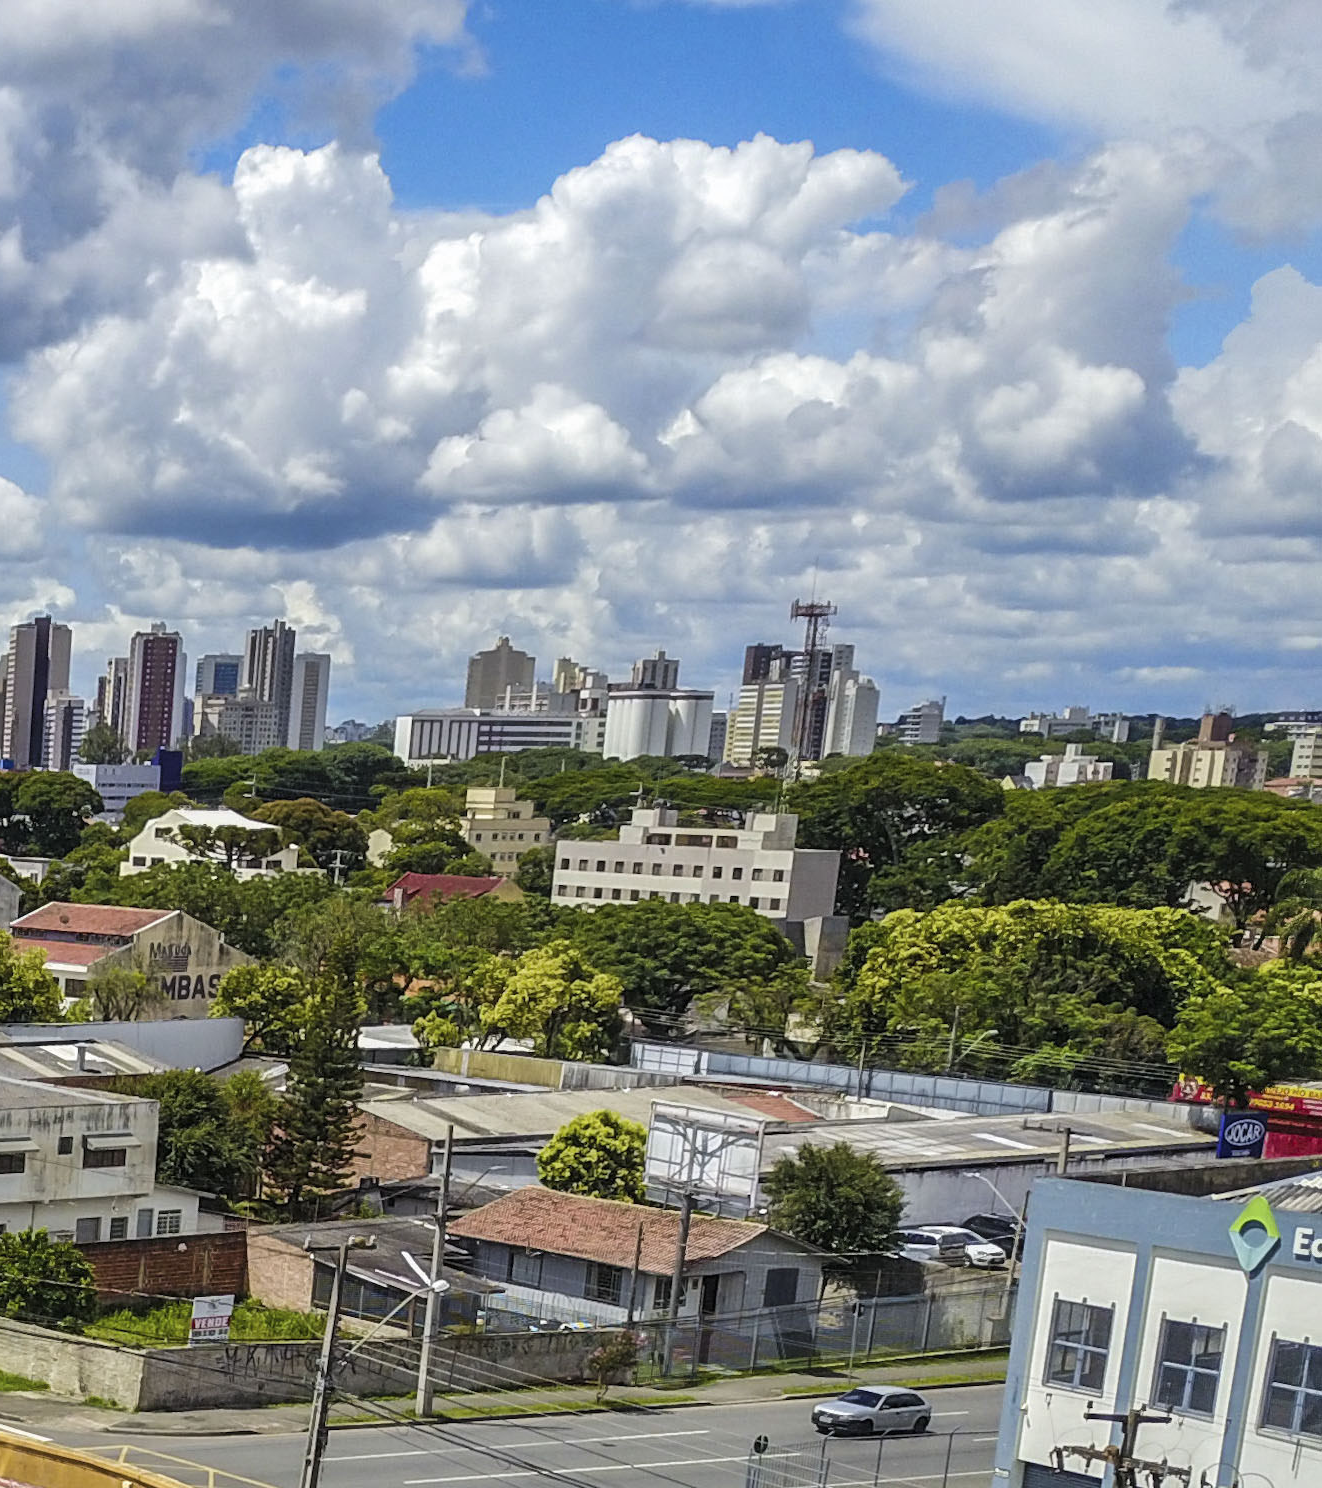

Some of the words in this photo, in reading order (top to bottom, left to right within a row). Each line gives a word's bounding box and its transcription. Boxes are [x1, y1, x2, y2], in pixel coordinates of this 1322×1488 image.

[159, 973, 222, 1001] MBAS
[1228, 1122, 1261, 1143] JOCAR
[194, 1316, 230, 1329] VENDE
